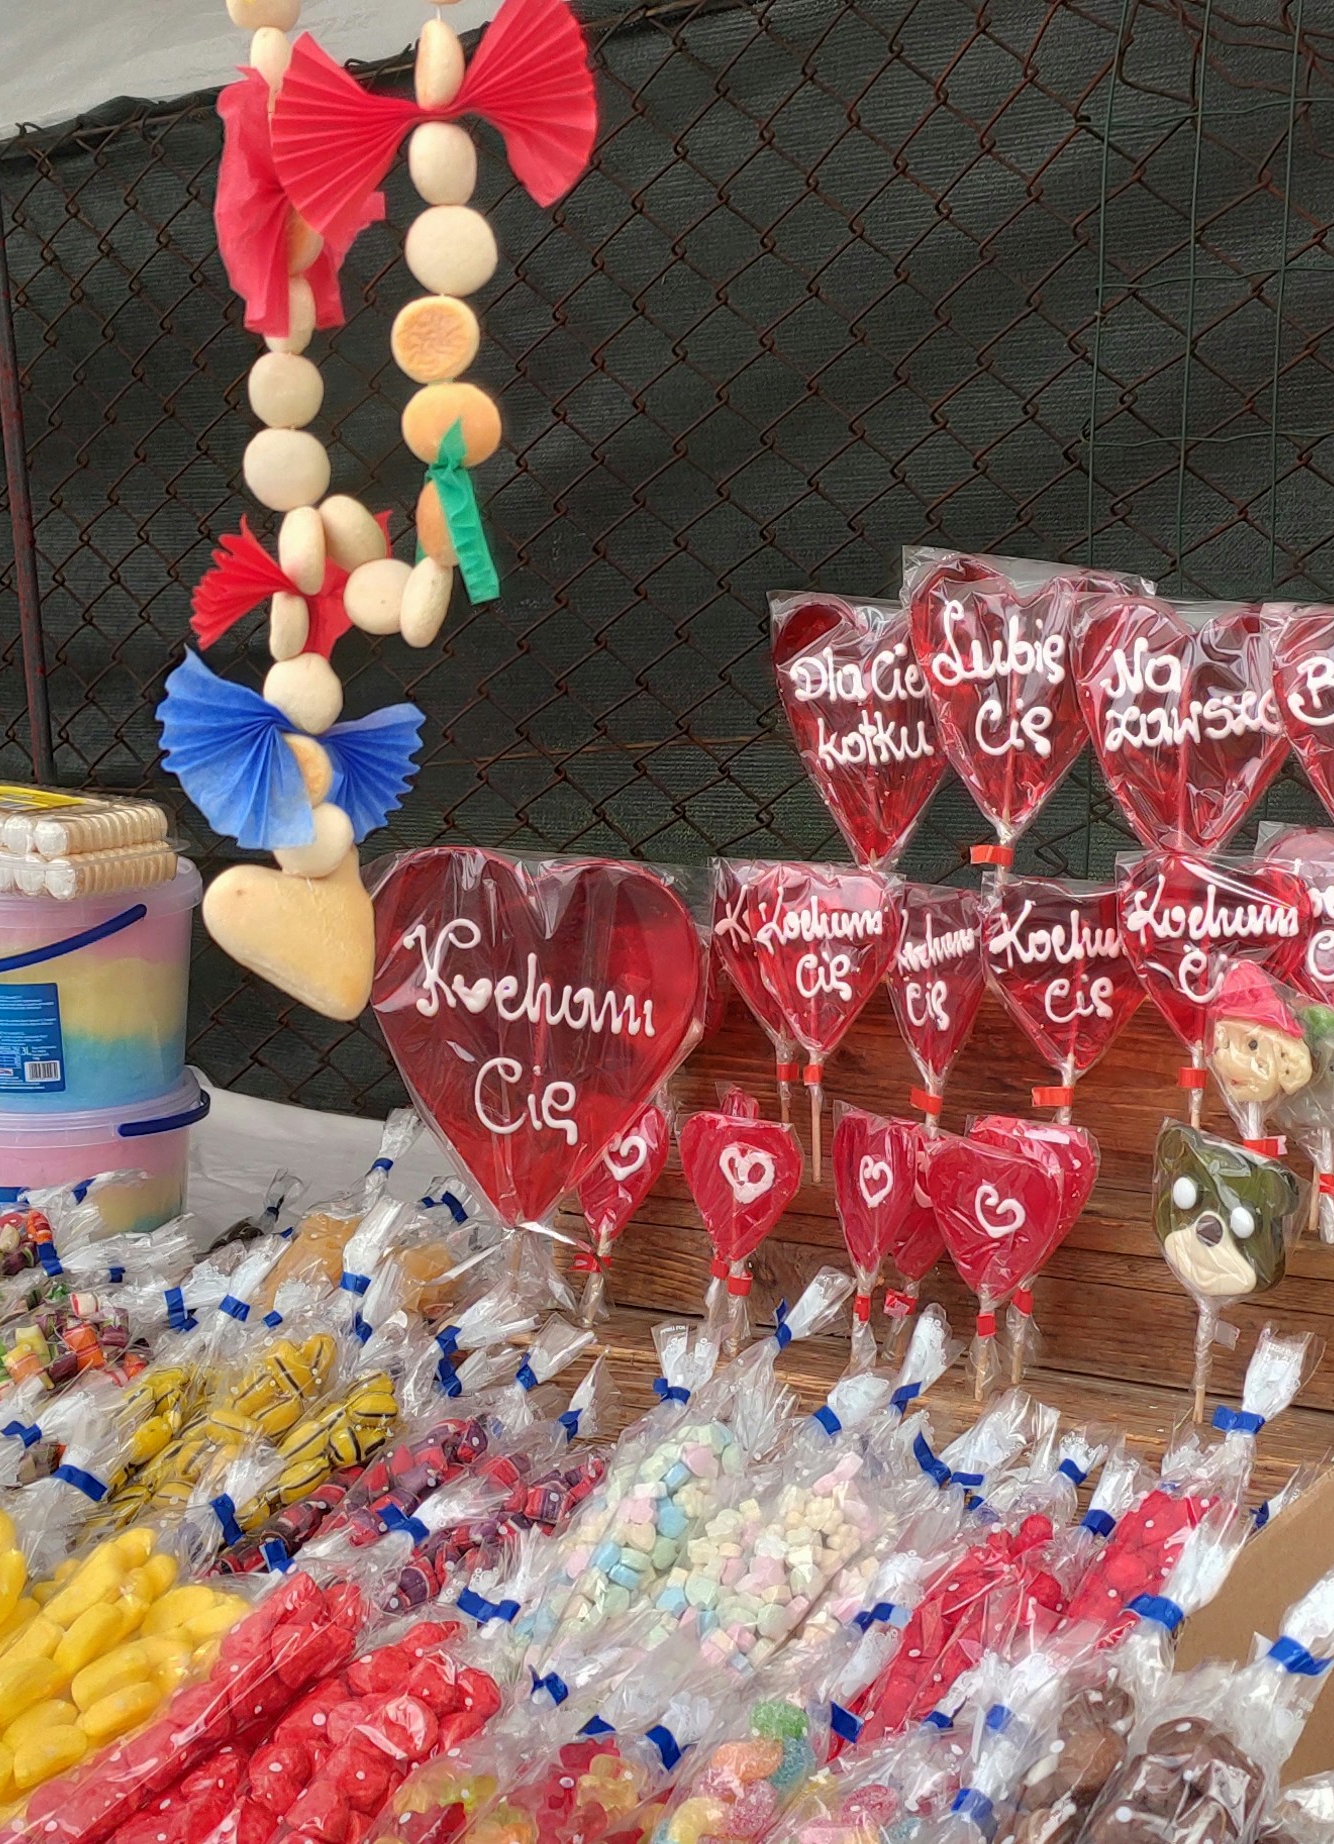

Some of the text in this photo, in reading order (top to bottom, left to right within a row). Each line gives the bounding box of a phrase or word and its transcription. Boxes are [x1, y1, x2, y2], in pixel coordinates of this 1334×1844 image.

[932, 599, 1065, 687] Lubię
[1100, 637, 1181, 698] Na
[789, 646, 868, 702] Dla
[818, 709, 935, 770] kotku
[975, 698, 1053, 759] Cię
[796, 951, 853, 1001] Cię
[1044, 974, 1115, 1023] Cię
[1177, 944, 1227, 1004] Ci
[905, 979, 950, 1031] Cię
[475, 1057, 578, 1145] Cię
